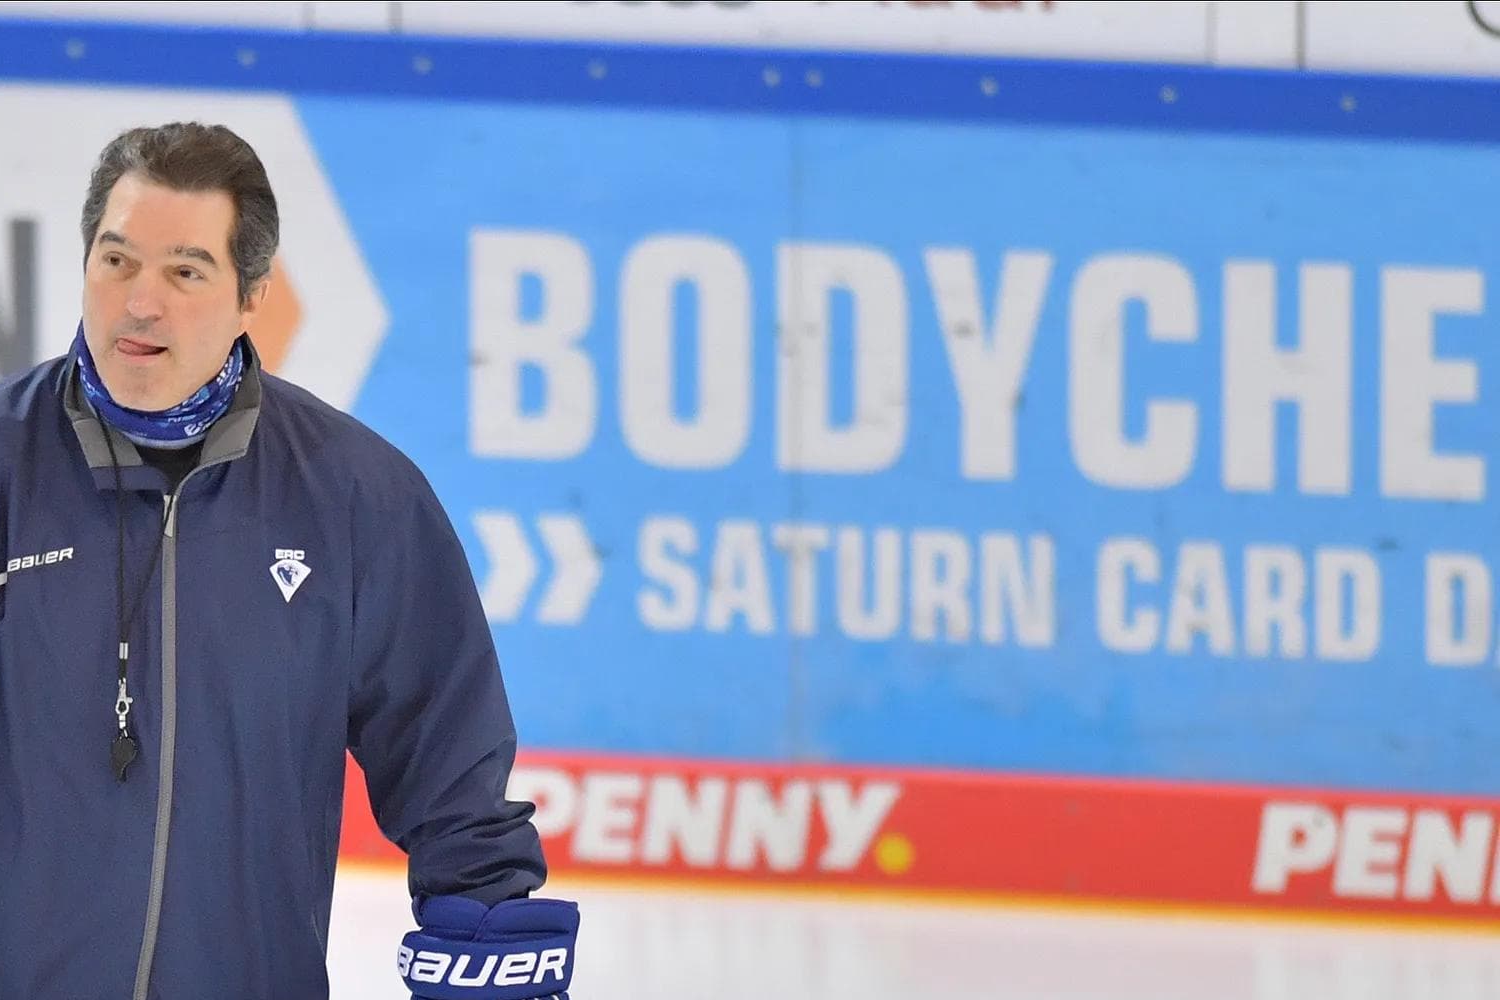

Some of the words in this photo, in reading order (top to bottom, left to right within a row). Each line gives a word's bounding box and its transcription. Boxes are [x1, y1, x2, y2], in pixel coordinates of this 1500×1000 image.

[467, 227, 1486, 500] BODYCHE
[637, 515, 1057, 648] SATURN
[1098, 536, 1382, 663] CARD
[1424, 551, 1500, 668] D
[1251, 801, 1500, 905] PEN
